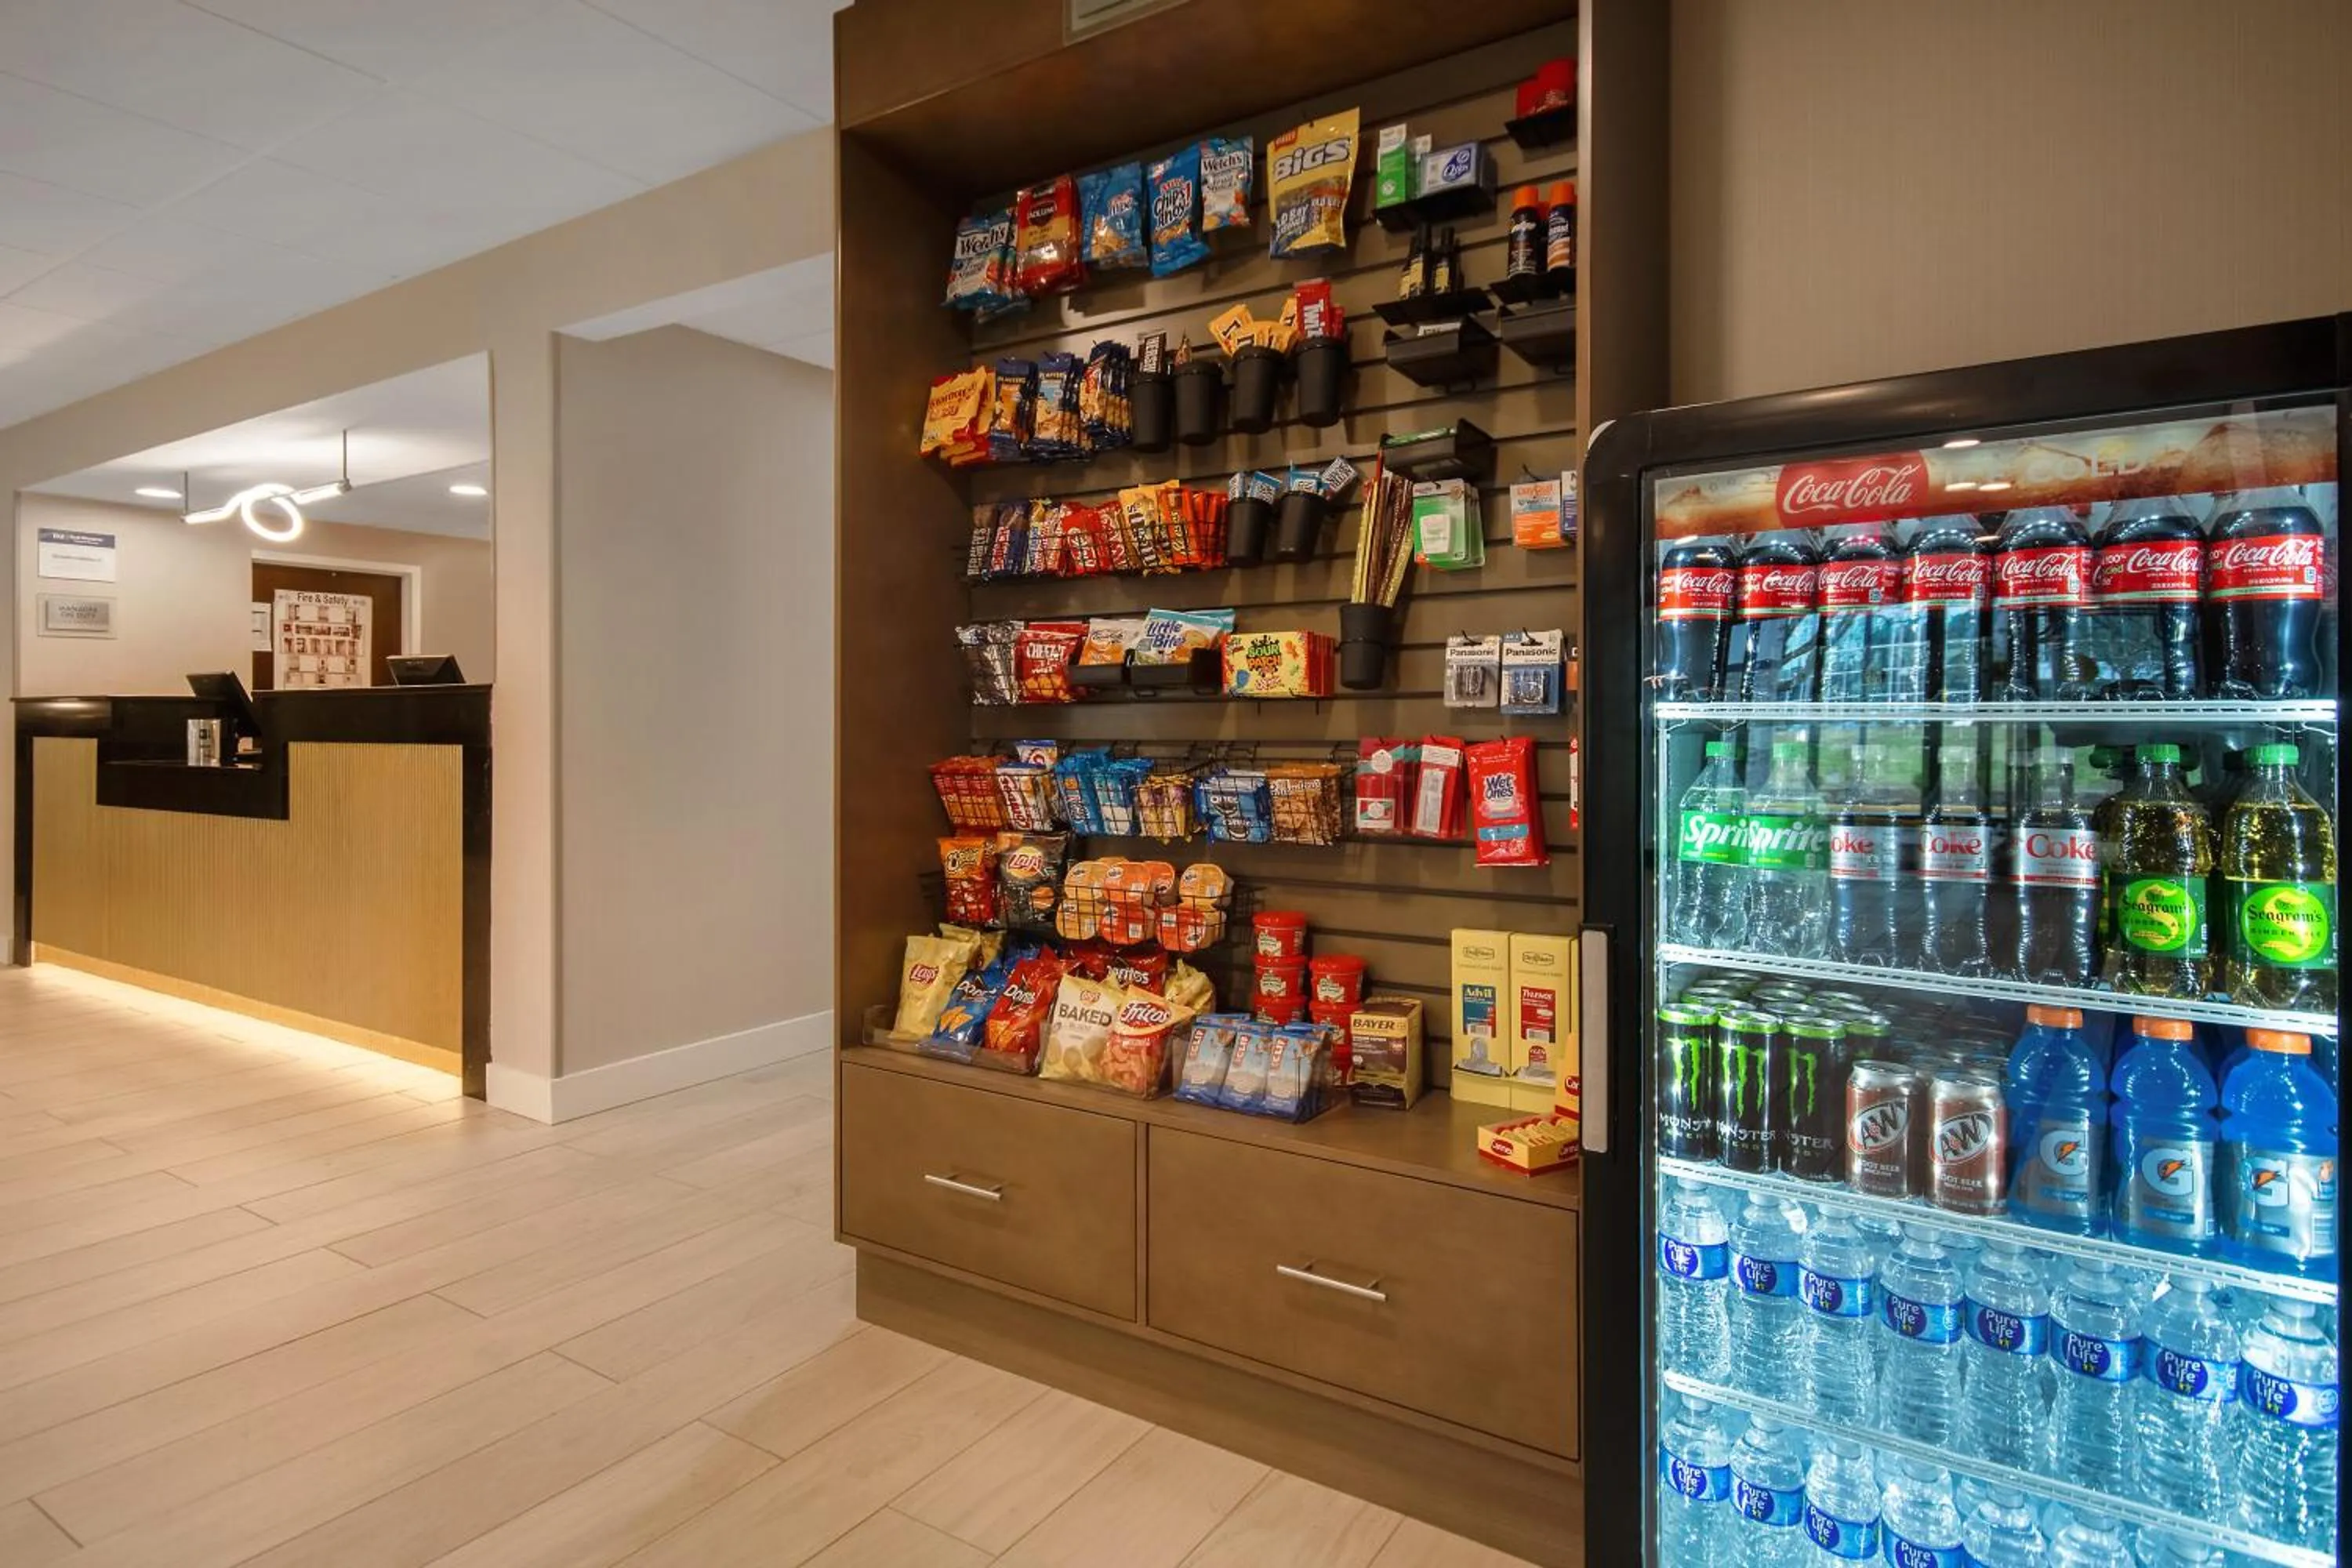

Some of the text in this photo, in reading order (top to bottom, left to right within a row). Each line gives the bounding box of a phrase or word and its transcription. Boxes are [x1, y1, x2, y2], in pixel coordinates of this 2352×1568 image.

[960, 225, 1007, 255] Welch's
[1783, 463, 1921, 514] Coca-Cola
[2128, 546, 2200, 573] Coca-Col
[2226, 539, 2318, 569] Coca-Cola
[1914, 558, 1984, 584] Coca-Cola
[2002, 553, 2078, 581] Coca-Cola
[1677, 572, 1734, 594] Coca-Cola
[1819, 565, 1883, 591] Coca-Cola
[297, 593, 312, 603] Fire
[322, 595, 349, 608] Safety
[1148, 620, 1183, 637] Little
[1247, 645, 1280, 657] SOUR
[1247, 655, 1281, 667] PATCH
[1450, 648, 1495, 657] Panasonic
[1505, 648, 1557, 657] Panasonic
[1486, 775, 1514, 789] Wet
[1486, 785, 1514, 800] Ones
[1749, 820, 1827, 855] Sprite
[1831, 832, 1875, 854] oke
[2026, 833, 2096, 861] Coke
[2123, 892, 2191, 917] Seagram's
[2247, 903, 2322, 926] Seagram's
[1465, 988, 1492, 998] Advil
[1058, 1004, 1112, 1027] BAKED
[1353, 1019, 1394, 1029] BAYER
[1660, 1112, 1711, 1131] MONST
[1861, 1102, 1900, 1150] A&W
[1941, 1114, 1981, 1163] A&W
[2142, 1148, 2194, 1196] G
[1742, 1256, 1771, 1272] Pure
[1746, 1267, 1768, 1283] Life
[1809, 1272, 1836, 1290] Pure
[1811, 1283, 1832, 1302] Life
[1891, 1296, 1920, 1316] Pure
[1894, 1307, 1916, 1325] Life
[1986, 1310, 2018, 1329] Pure
[1989, 1320, 2014, 1342] Life
[2069, 1334, 2104, 1353] Pure
[2071, 1345, 2100, 1365] Life
[2165, 1351, 2201, 1372] Pure
[2168, 1363, 2196, 1385] Life
[2252, 1370, 2289, 1393] Pure
[2256, 1383, 2284, 1407] Life
[1677, 1460, 1701, 1478] Pure
[1742, 1482, 1769, 1500] Pure
[1810, 1505, 1835, 1528] Pure
[1901, 1541, 1931, 1561] Pure
